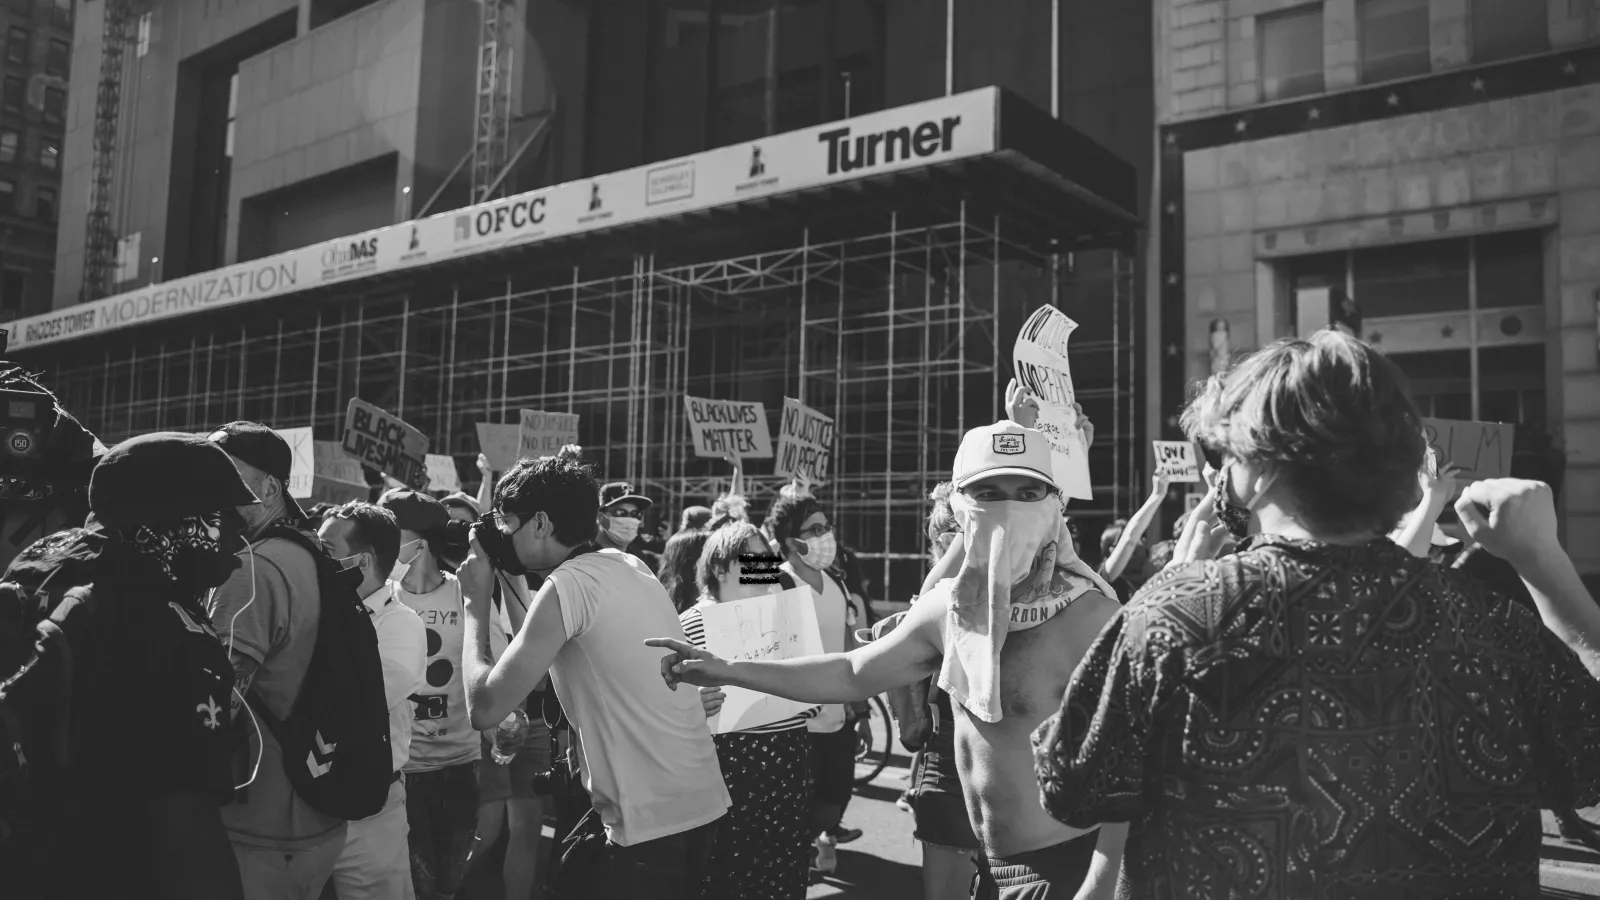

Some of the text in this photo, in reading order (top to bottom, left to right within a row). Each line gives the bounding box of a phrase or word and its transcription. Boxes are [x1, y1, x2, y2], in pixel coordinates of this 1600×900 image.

[818, 115, 961, 175] Turner
[476, 197, 546, 236] OFCC
[26, 317, 62, 342] RHODES
[100, 260, 298, 326] MODERNIZATION
[14, 438, 27, 448] 150
[353, 406, 407, 450] BLACK
[522, 434, 539, 450] NO
[702, 428, 758, 452] MATTER
[783, 406, 834, 450] NO JUSTICE
[780, 440, 797, 472] NO
